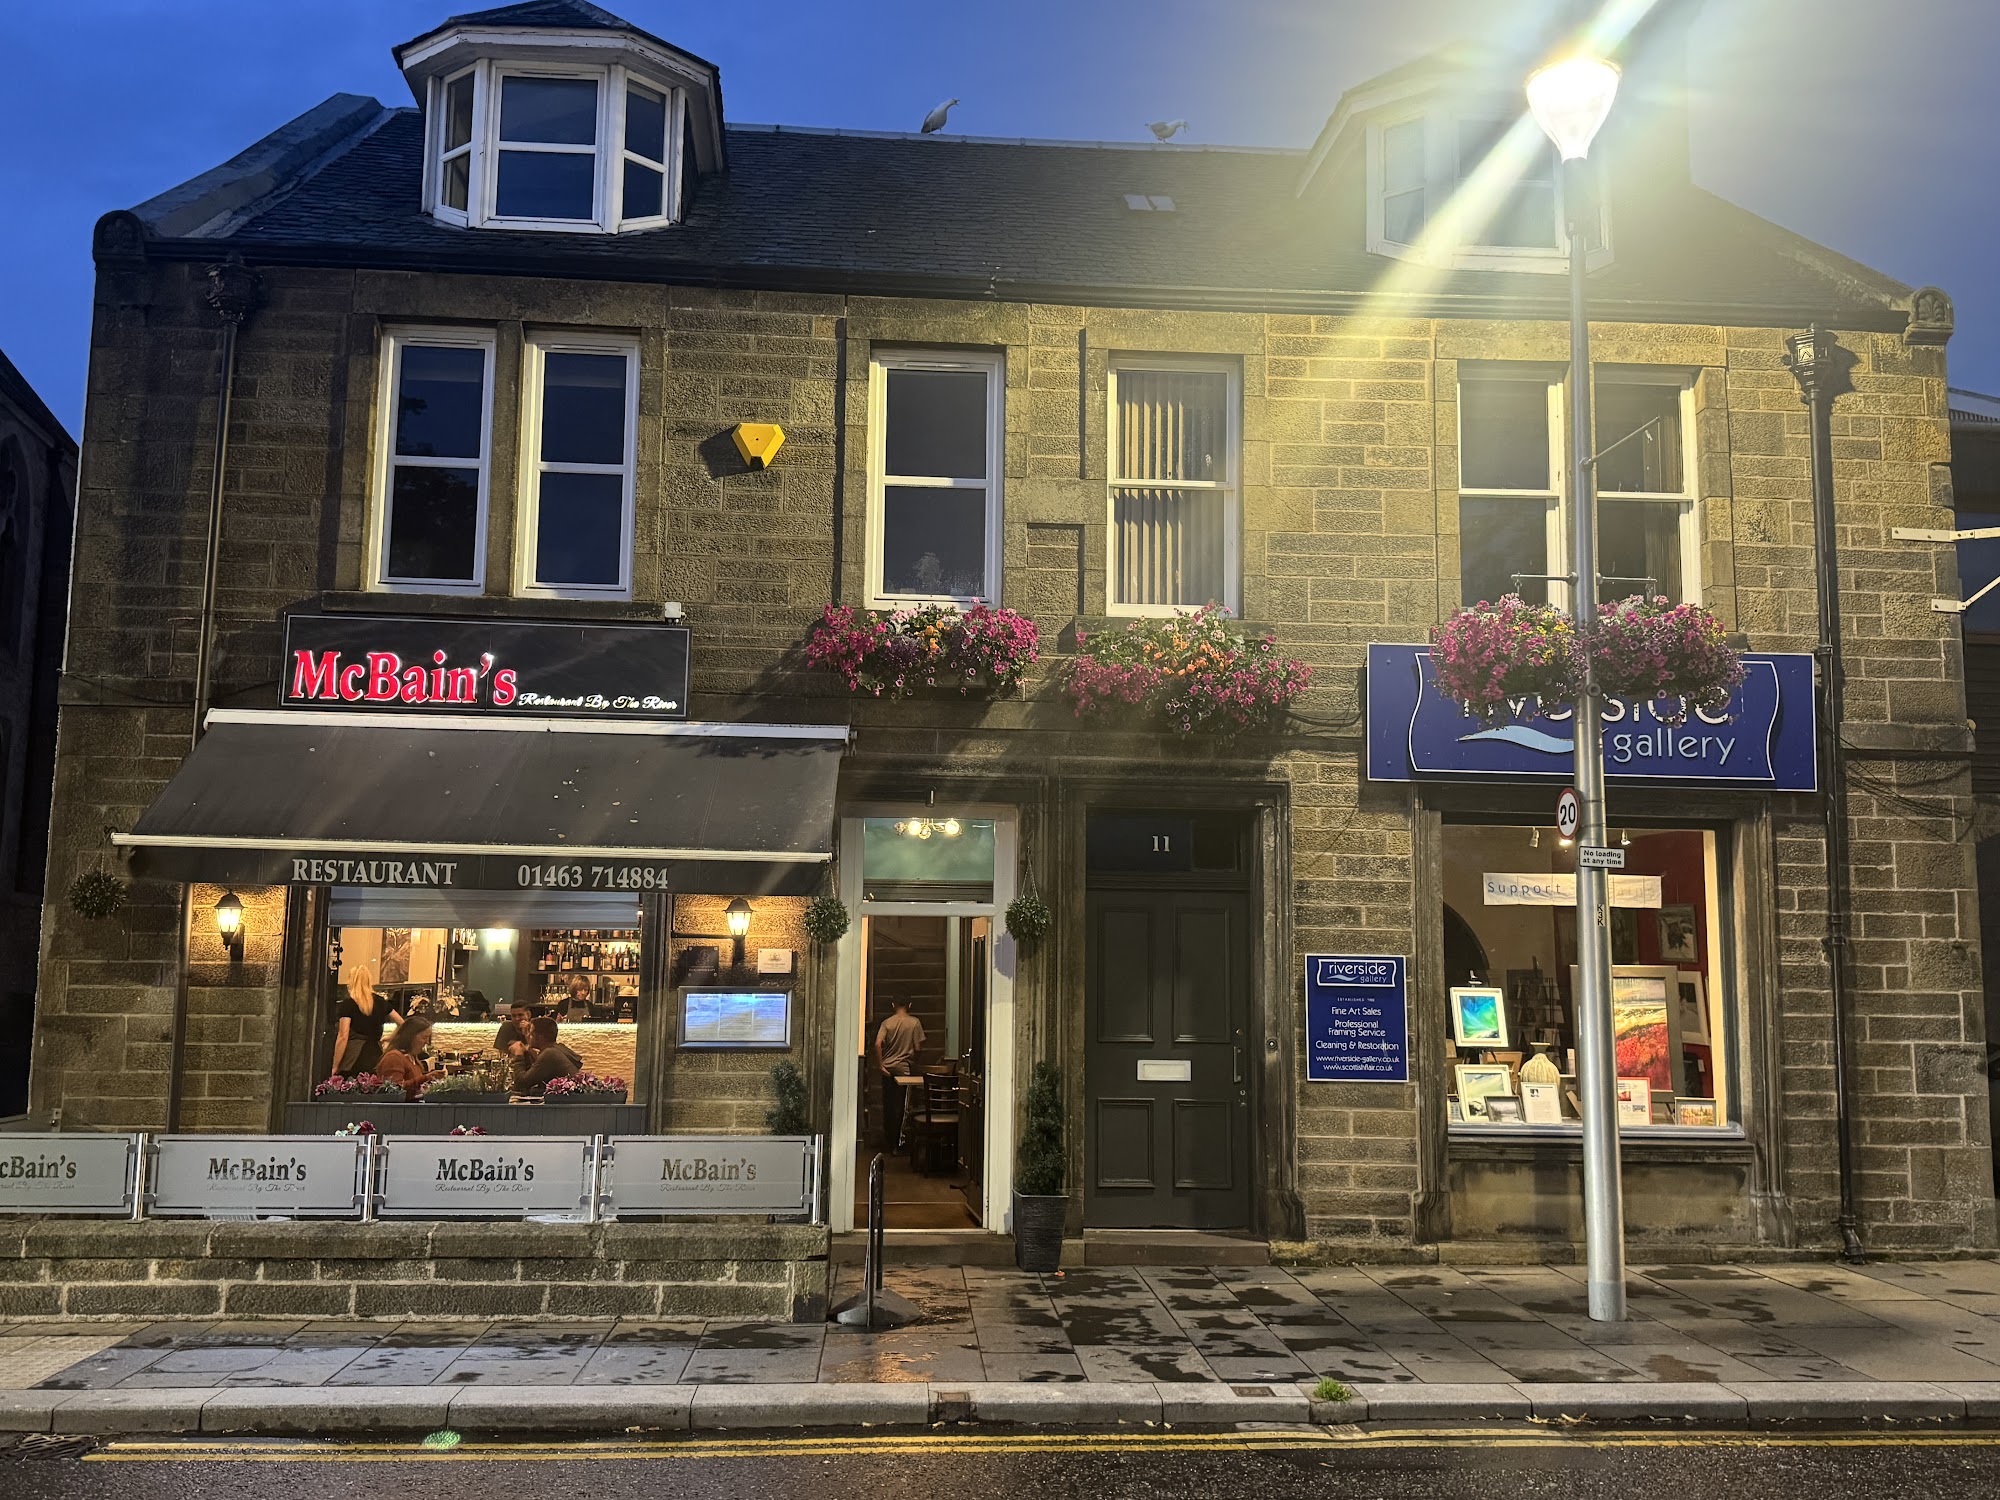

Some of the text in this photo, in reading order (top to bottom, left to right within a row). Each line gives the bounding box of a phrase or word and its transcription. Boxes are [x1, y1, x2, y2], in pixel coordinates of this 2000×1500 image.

[289, 650, 517, 706] McBain's
[518, 692, 678, 710] Restaurant By The River
[1462, 685, 1730, 724] veside
[1612, 728, 1736, 765] gallery
[1560, 803, 1577, 825] 20
[1152, 835, 1170, 851] 11
[1583, 850, 1621, 859] No loading
[291, 859, 457, 885] RESTAURANT
[517, 864, 668, 889] 01463 714884
[1487, 881, 1562, 896] Support
[1329, 962, 1387, 974] riverside
[1360, 976, 1387, 984] gallery
[1331, 1007, 1382, 1016] Fine Art Sales
[1334, 1020, 1379, 1028] Professional
[1328, 1028, 1386, 1037] Framing Service
[1315, 1040, 1399, 1050] Cleaning & Restoration
[1316, 1055, 1400, 1063] www.riverside-gallery.co.uk
[1323, 1063, 1393, 1072] www.scottishflair.co.uk
[0, 1154, 77, 1179] cBain's
[207, 1156, 307, 1181] McBain's
[436, 1156, 534, 1181] McBain's
[660, 1156, 757, 1181] McBain's
[264, 1183, 281, 1192] The
[434, 1183, 475, 1192] Restaurant
[475, 1183, 491, 1194] By
[493, 1183, 510, 1193] The
